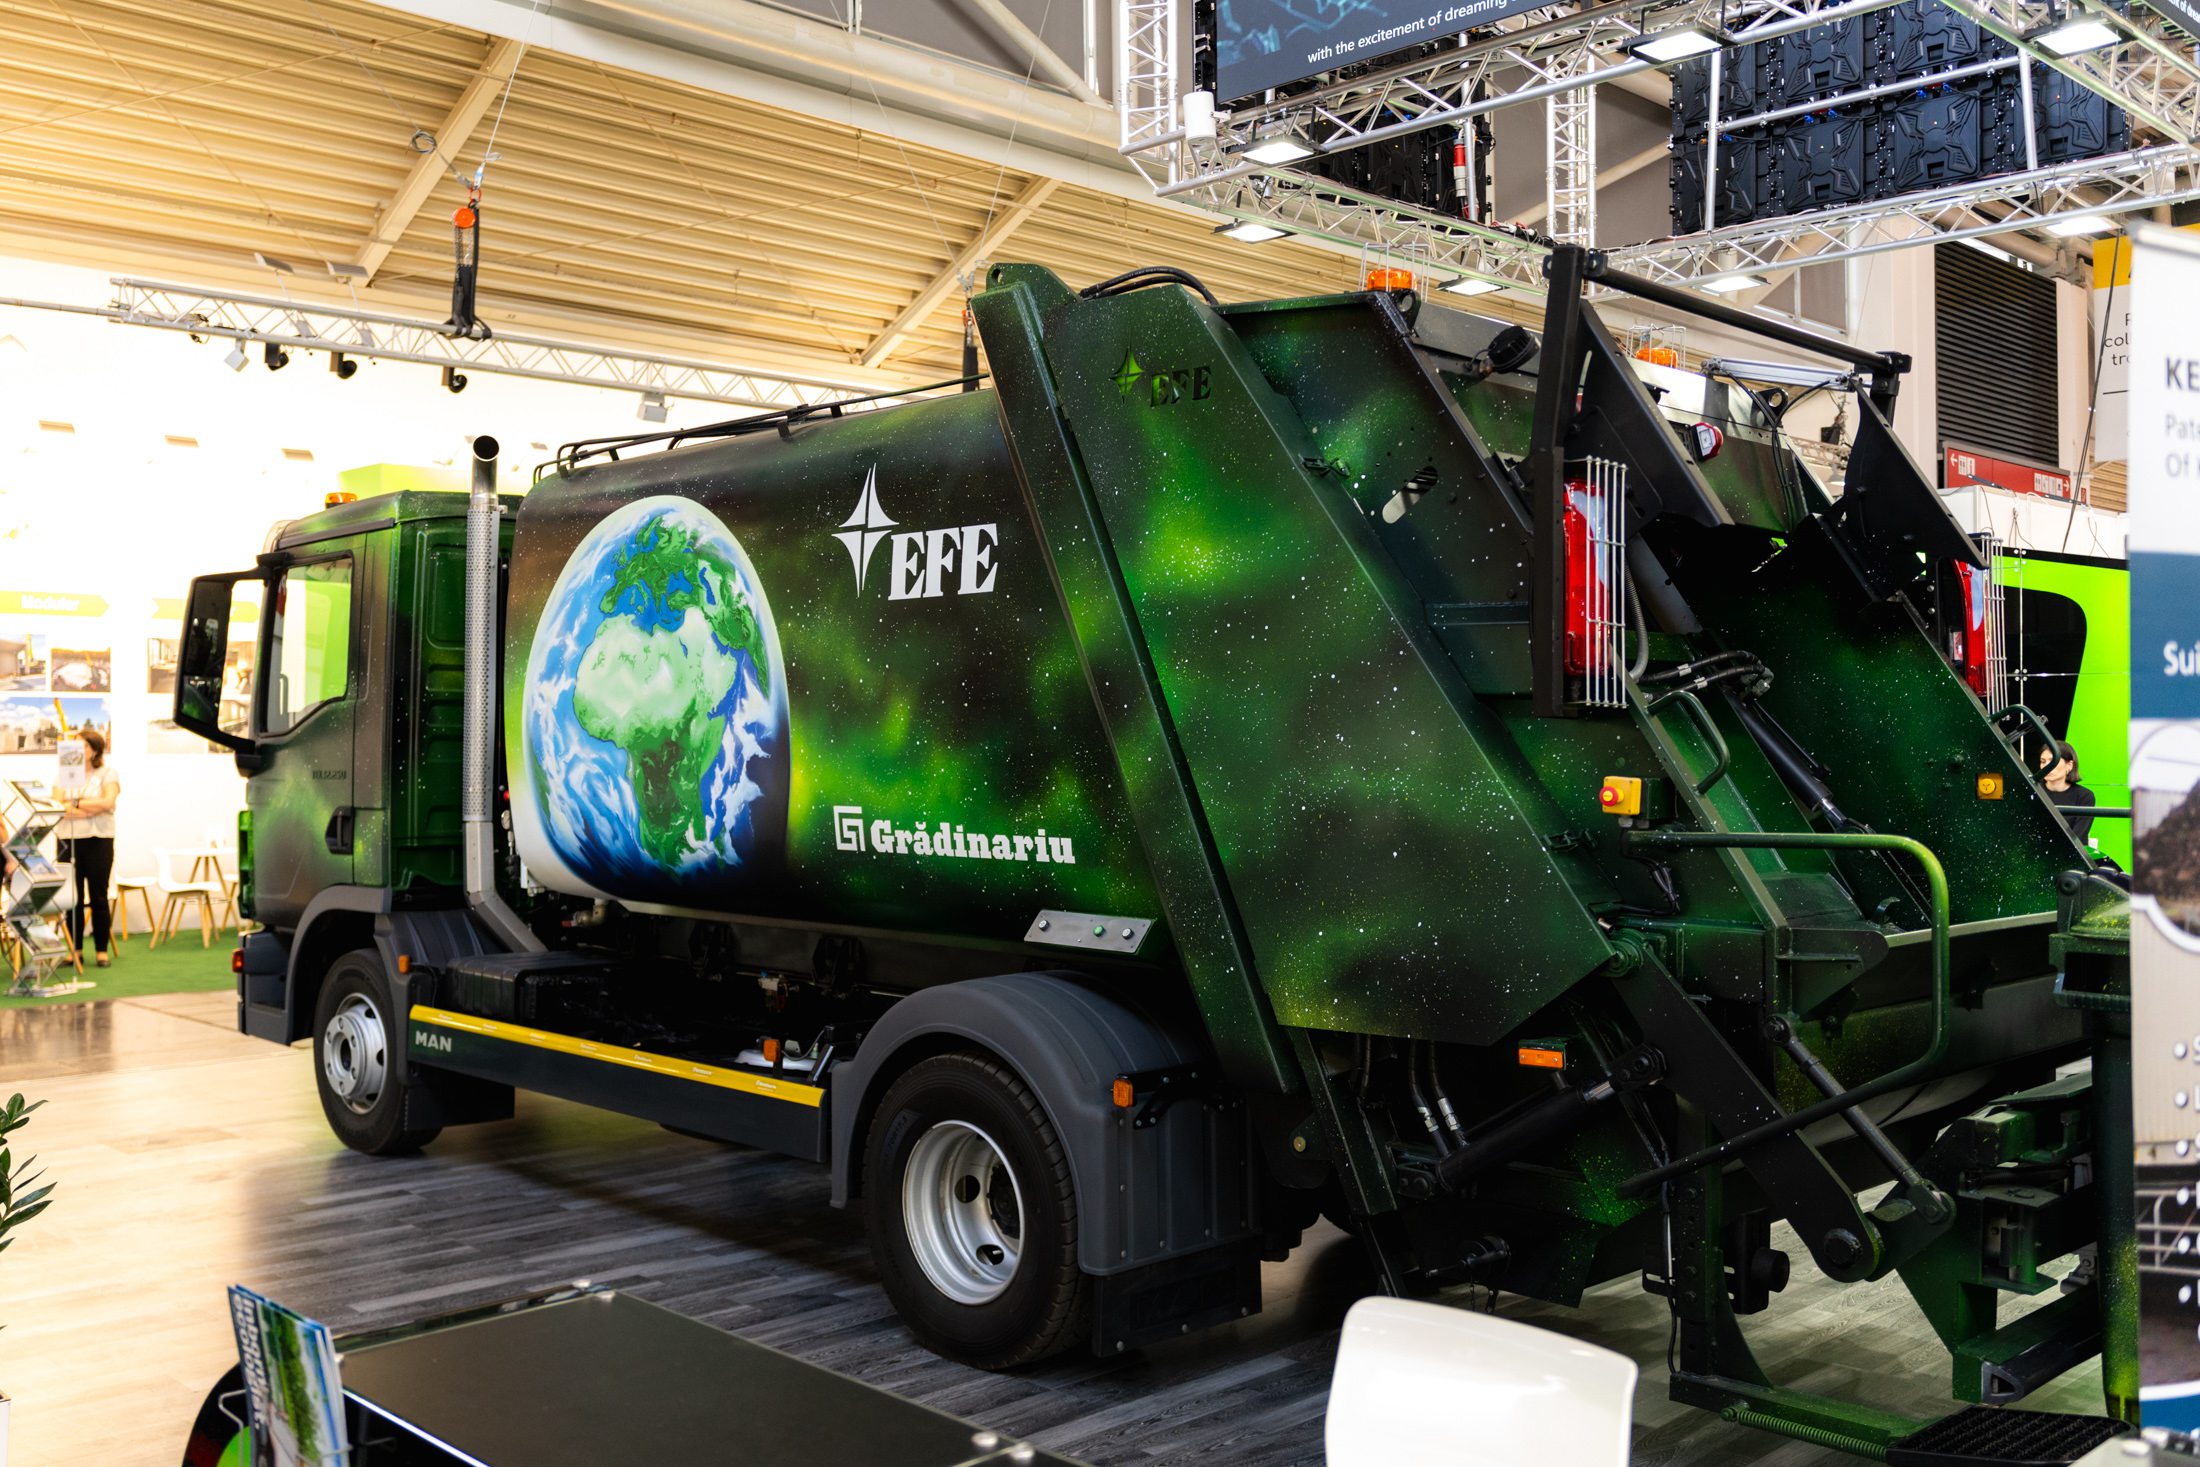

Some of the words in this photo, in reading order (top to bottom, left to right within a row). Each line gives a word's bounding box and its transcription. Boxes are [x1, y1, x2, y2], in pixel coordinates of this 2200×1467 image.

[1307, 44, 1333, 63] with
[1335, 39, 1355, 55] the
[1358, 17, 1425, 48] excitement
[1428, 10, 1442, 27] of
[1444, 0, 1507, 22] dreaming
[1150, 365, 1212, 407] EFE
[888, 523, 999, 601] EFE
[870, 819, 1076, 865] Grădinariu
[415, 1030, 453, 1053] MAN
